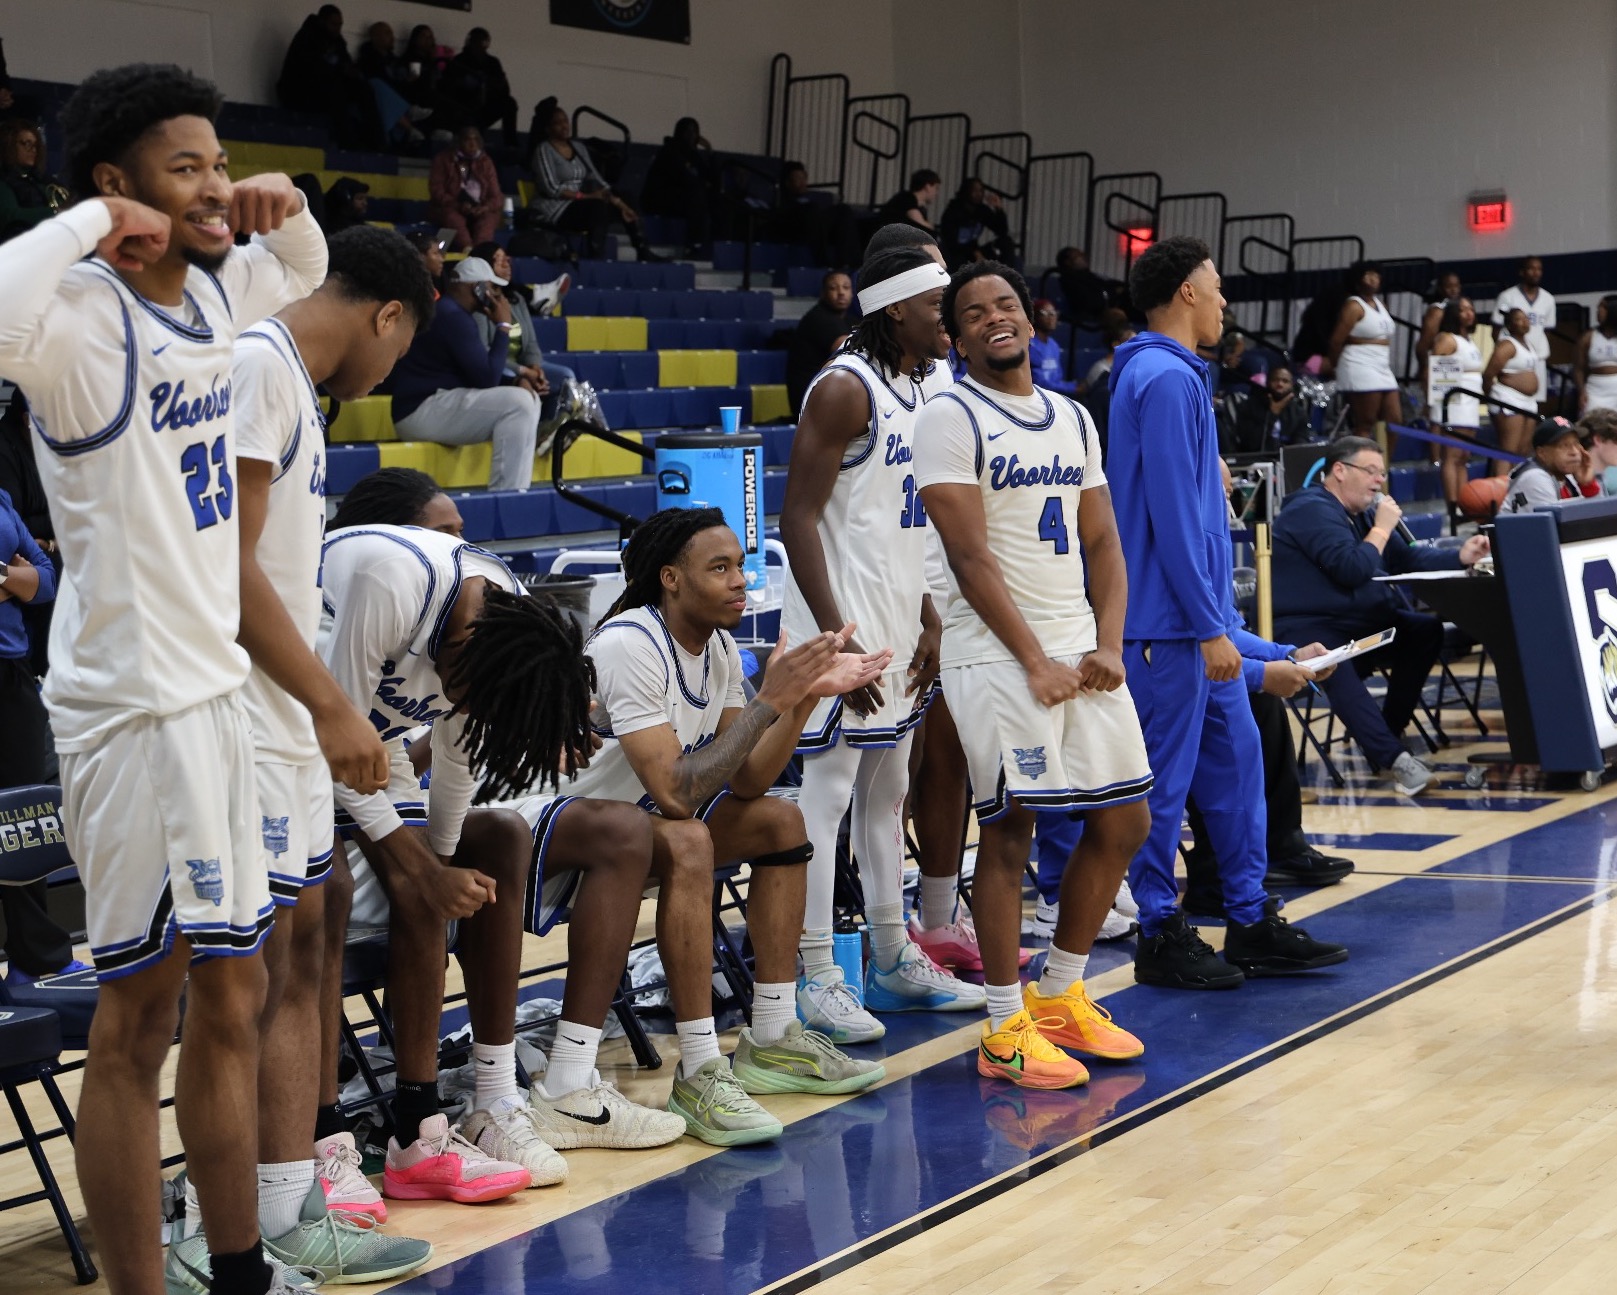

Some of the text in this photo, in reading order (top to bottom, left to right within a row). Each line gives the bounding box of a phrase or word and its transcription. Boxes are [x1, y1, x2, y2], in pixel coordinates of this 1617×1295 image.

[181, 433, 234, 532] 23
[744, 453, 757, 551] POWERADE
[1038, 496, 1069, 555] 4
[0, 806, 66, 854] GER
